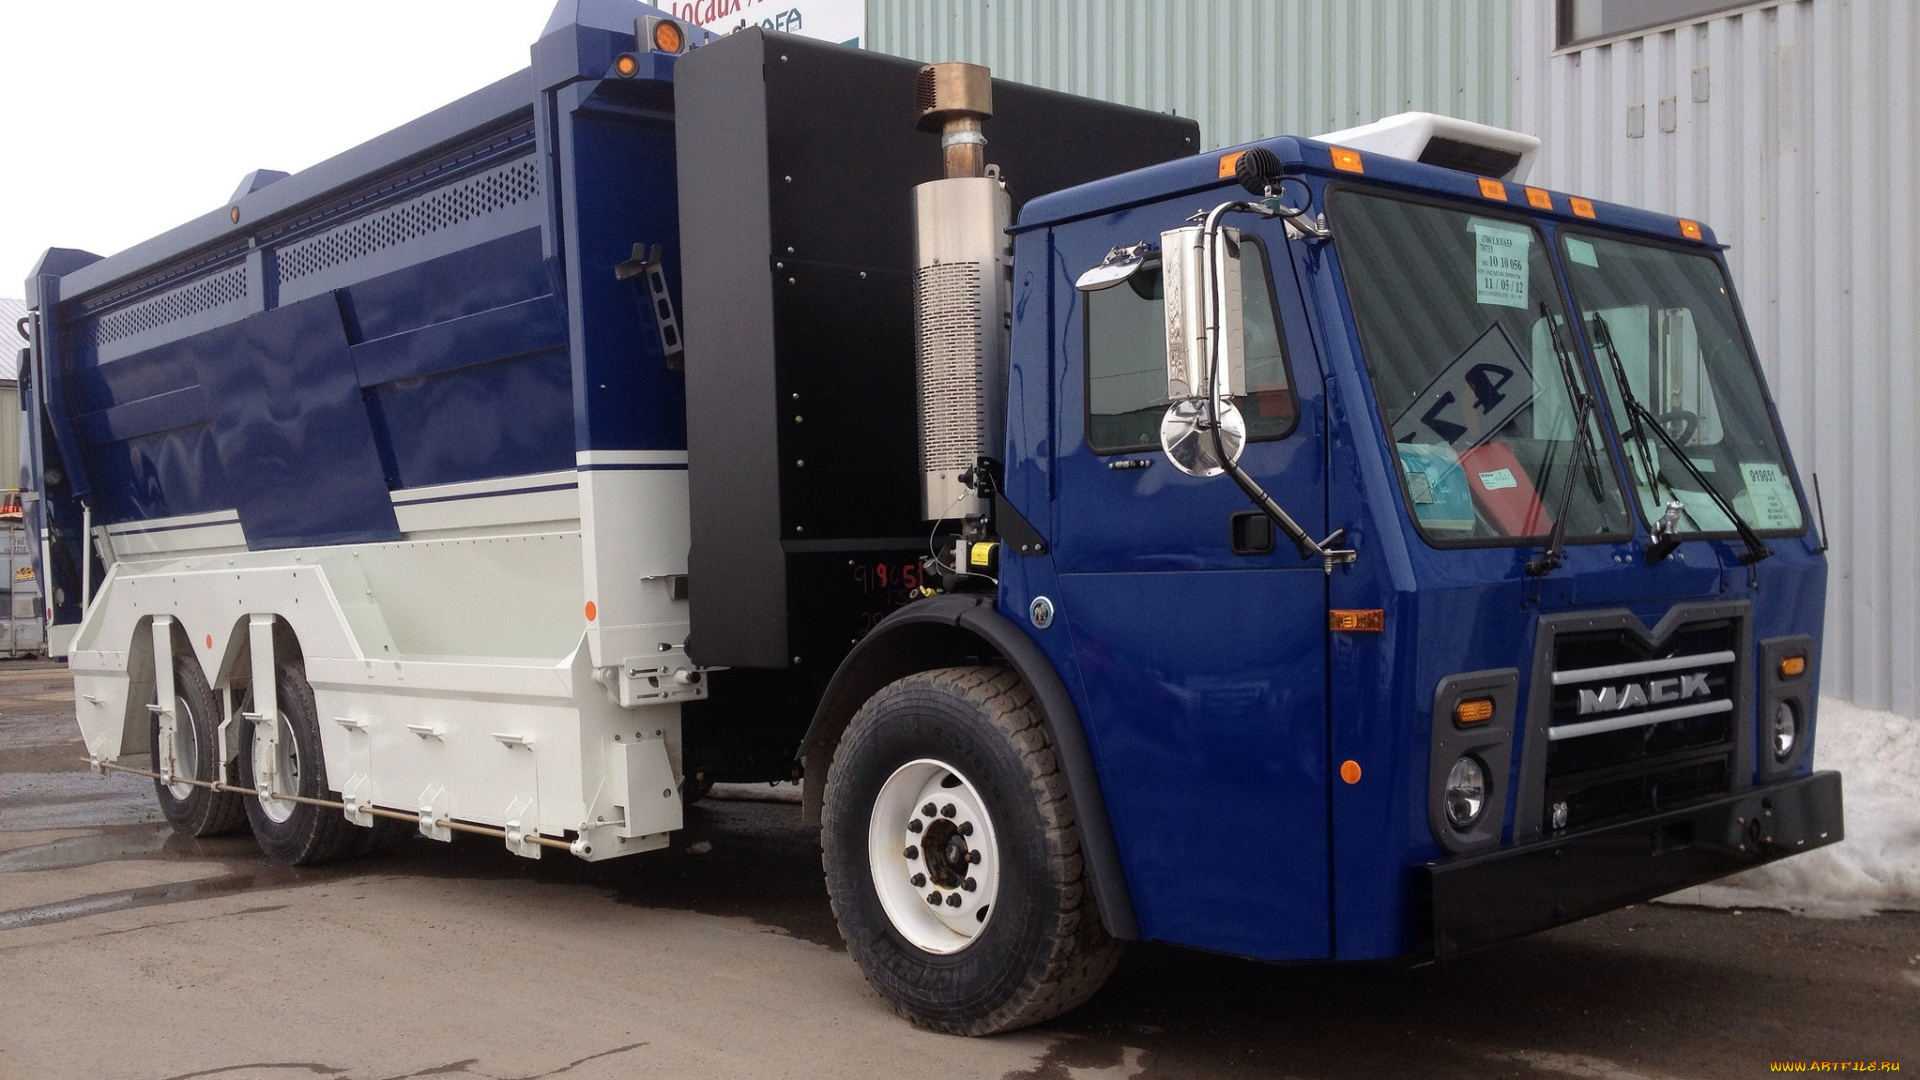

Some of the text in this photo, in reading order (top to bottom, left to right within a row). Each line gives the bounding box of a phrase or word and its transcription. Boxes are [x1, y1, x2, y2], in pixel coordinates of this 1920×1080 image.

[1489, 255, 1499, 268] 10
[1500, 257, 1509, 269] 10
[1484, 277, 1493, 289] 11
[1500, 278, 1510, 291] 05
[1515, 281, 1524, 293] 12
[1749, 469, 1777, 483] 919651
[1577, 672, 1711, 715] MACK
